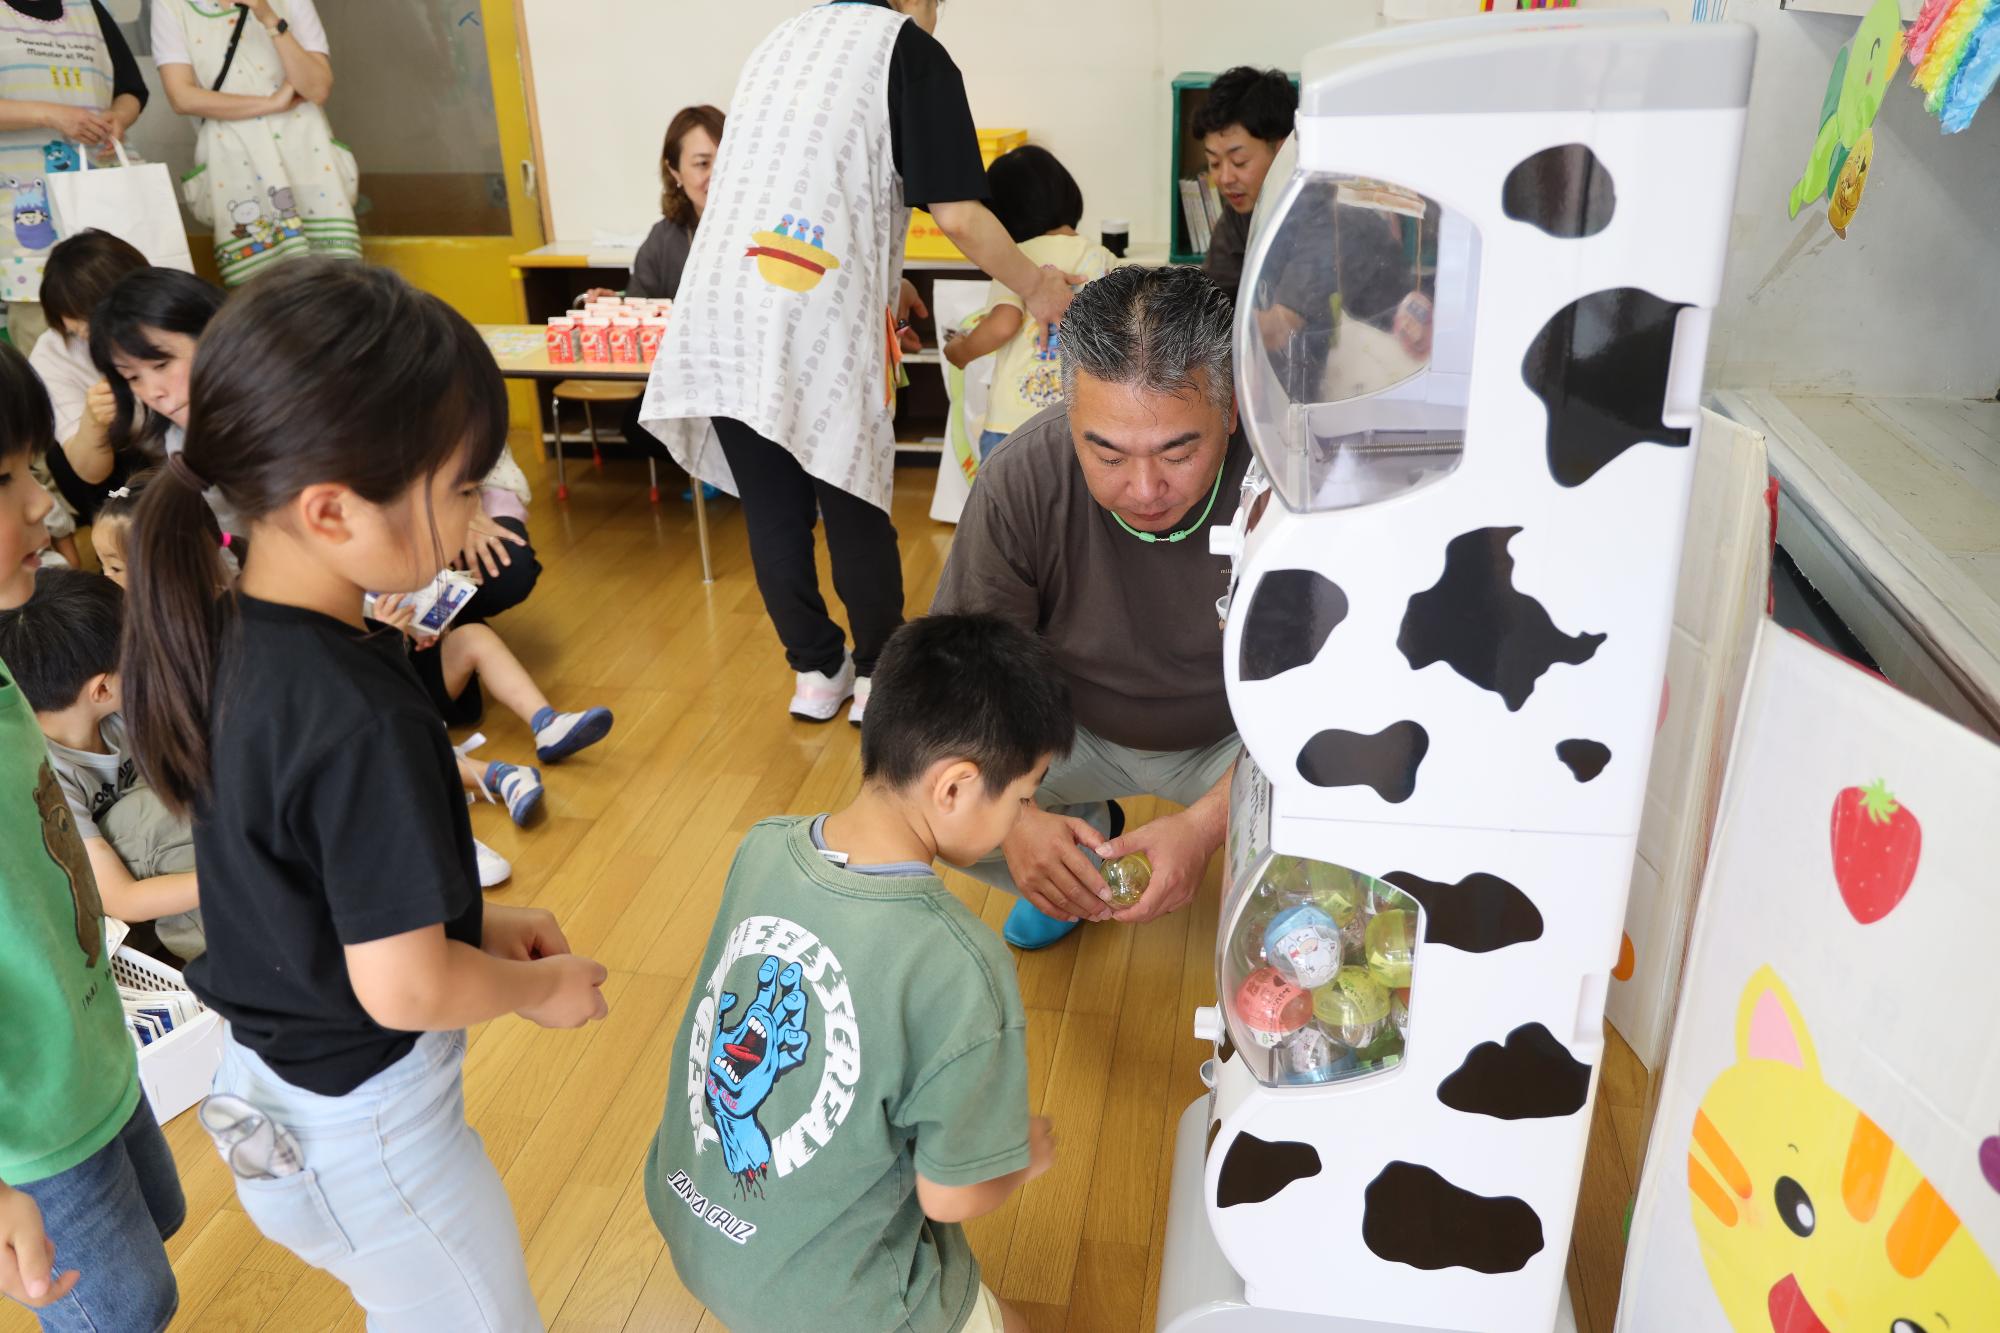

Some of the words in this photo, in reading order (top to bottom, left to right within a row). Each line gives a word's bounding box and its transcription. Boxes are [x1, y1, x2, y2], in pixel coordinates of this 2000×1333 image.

[771, 973, 861, 1178] SCREAM
[667, 1169, 708, 1215] SANTA
[704, 1204, 755, 1243] CRUZ
